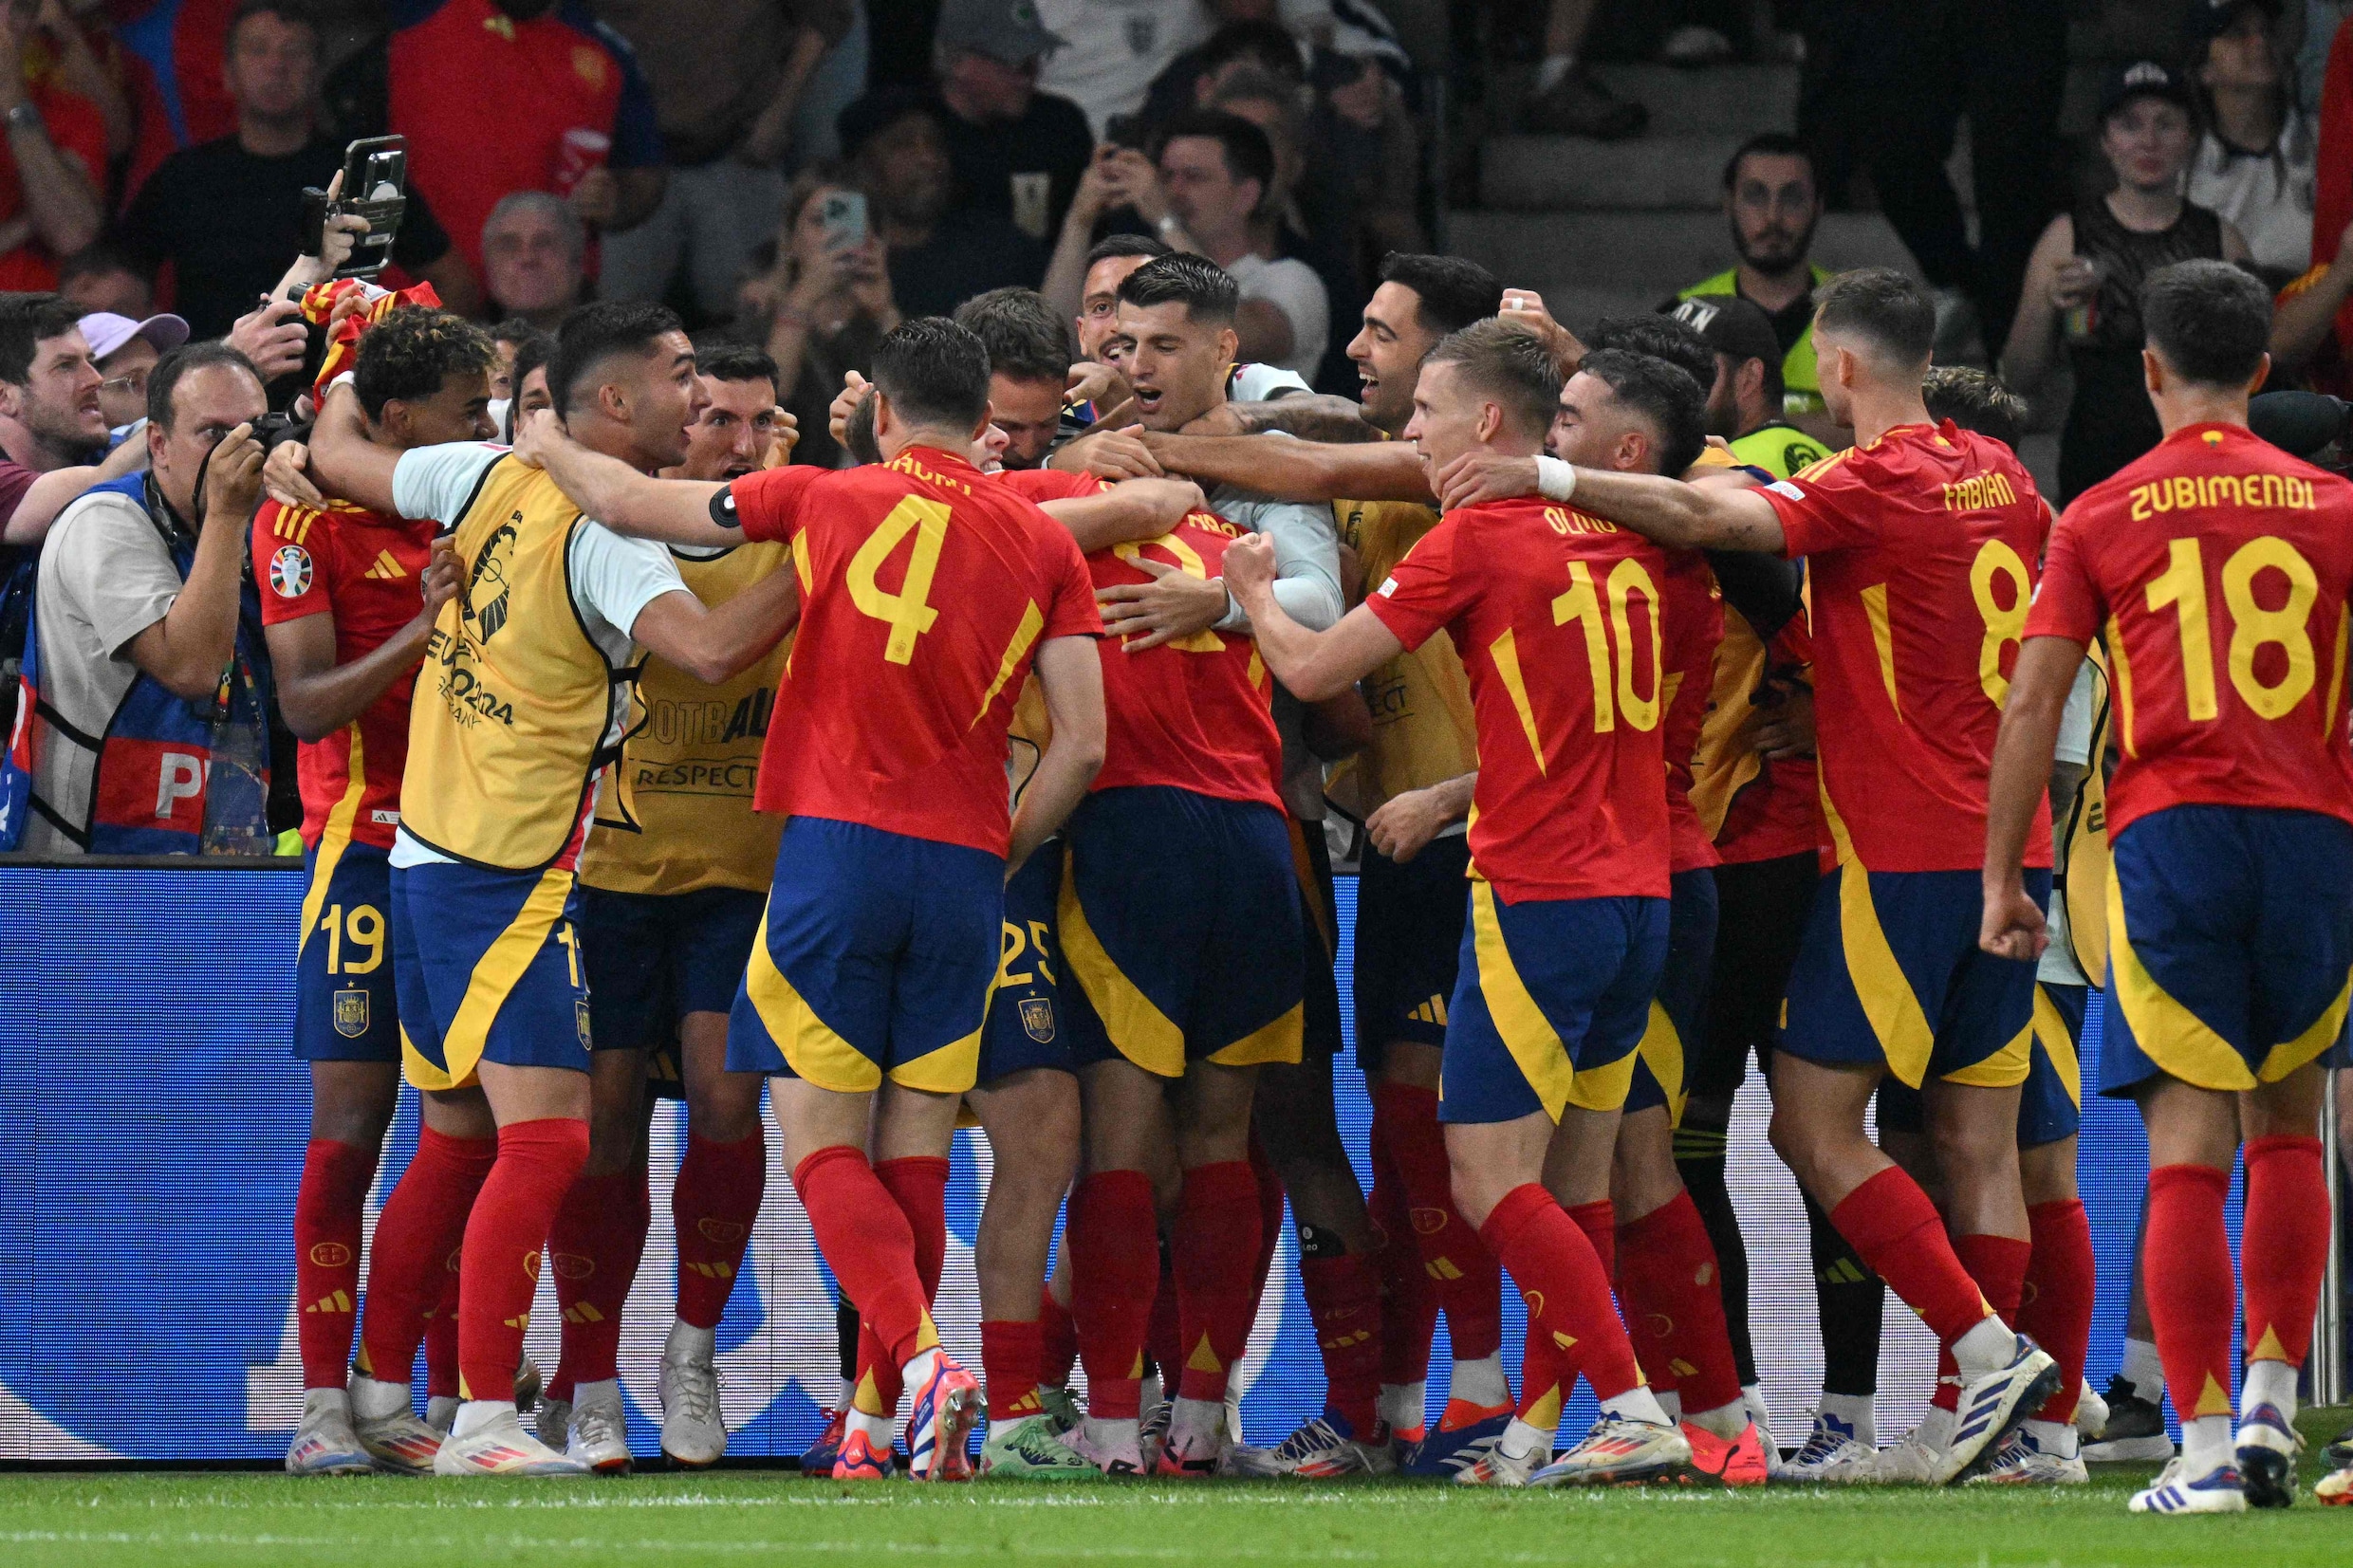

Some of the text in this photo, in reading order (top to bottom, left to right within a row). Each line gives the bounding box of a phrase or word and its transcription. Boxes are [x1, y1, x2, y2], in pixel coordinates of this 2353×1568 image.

[1544, 507, 1618, 535] OLMO
[1941, 469, 2017, 511] FABIÁN
[2129, 474, 2317, 523] ZUBIMENDI
[845, 493, 953, 666] 4
[1551, 557, 1663, 733] 10
[1970, 538, 2032, 712] 8
[2145, 535, 2319, 721] 18
[637, 763, 759, 790] RESPECT
[321, 903, 385, 974] 19
[556, 921, 581, 988] 1
[999, 919, 1057, 988] 25
